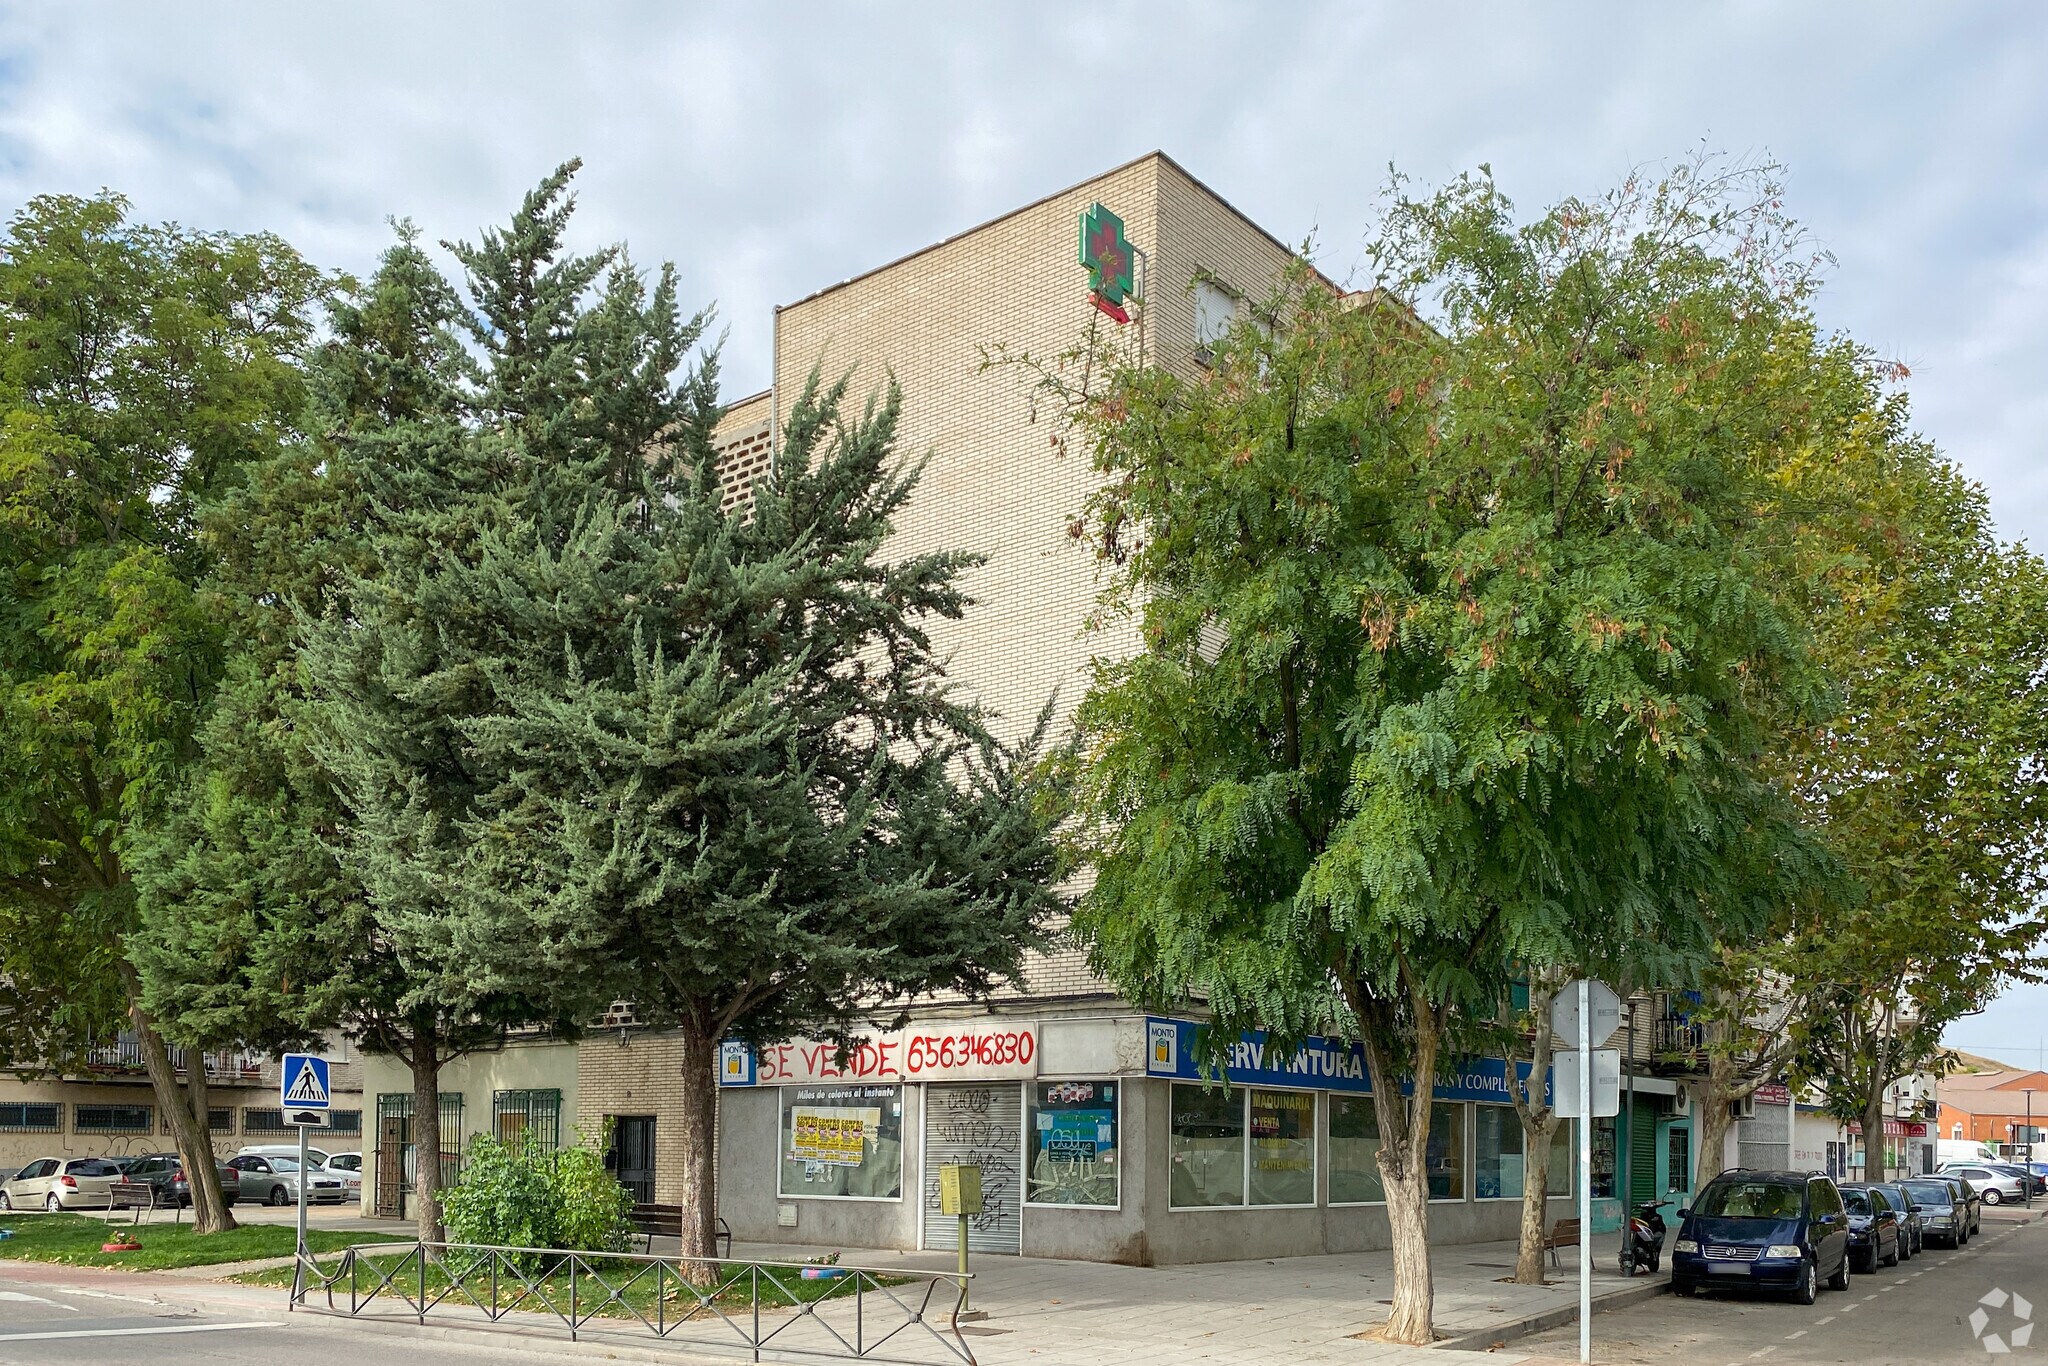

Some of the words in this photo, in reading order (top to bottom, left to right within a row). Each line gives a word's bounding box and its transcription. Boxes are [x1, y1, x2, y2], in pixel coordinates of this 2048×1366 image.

[1152, 1028, 1175, 1038] MONTO
[724, 1046, 748, 1054] MONTO
[761, 1045, 795, 1080] SE
[800, 1041, 899, 1077] VENDE
[1457, 1073, 1465, 1089] Y
[797, 1089, 815, 1100] Miles
[816, 1089, 825, 1099] de
[828, 1088, 852, 1099] colores
[854, 1087, 862, 1098] al
[1253, 1093, 1310, 1111] MAQUINARIA
[1259, 1116, 1280, 1128] VENTA
